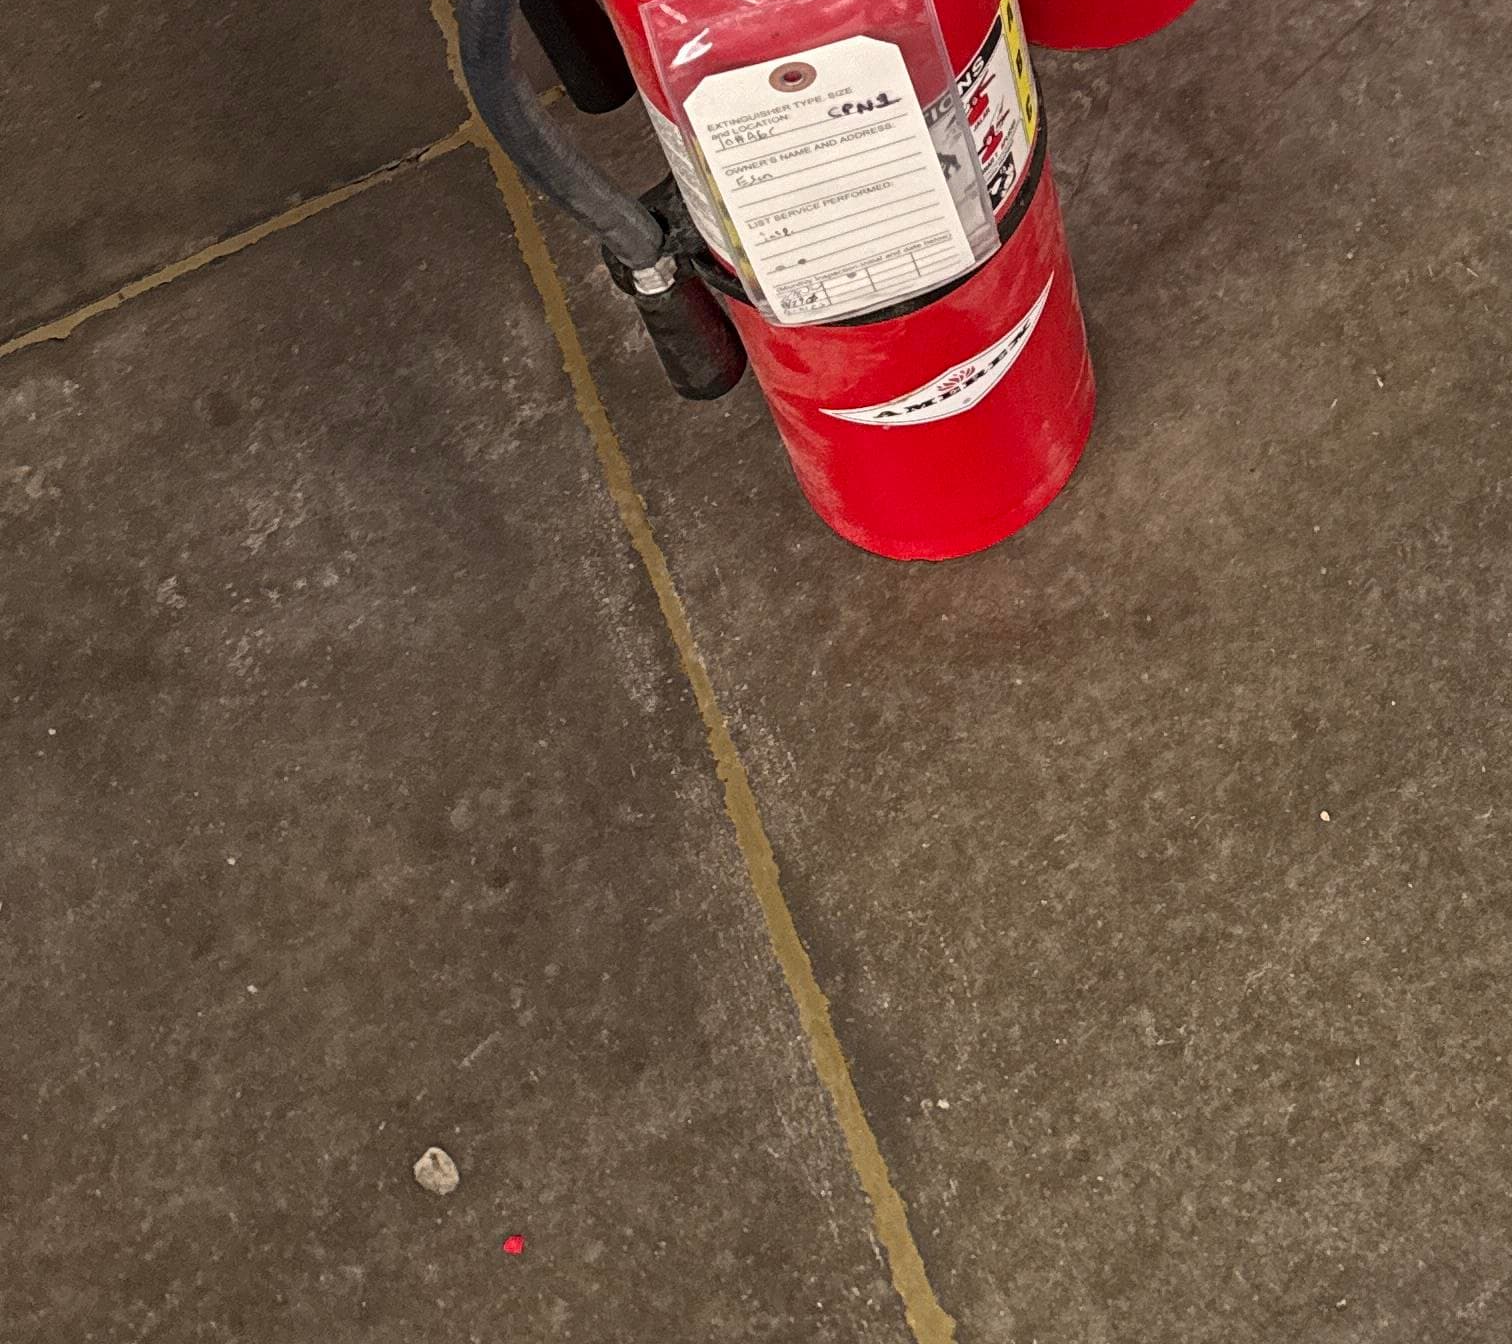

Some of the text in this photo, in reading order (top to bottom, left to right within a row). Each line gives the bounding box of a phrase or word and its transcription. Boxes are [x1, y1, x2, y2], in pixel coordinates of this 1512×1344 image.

[707, 104, 791, 131] EXTINGUISHER
[827, 87, 853, 99] SIZE
[724, 157, 777, 176] OWNER'S
[780, 143, 811, 160] NAME
[814, 139, 837, 151] AND
[747, 215, 771, 230] LIST
[774, 203, 820, 223] SERVICE
[872, 317, 1031, 419] AMEREX
